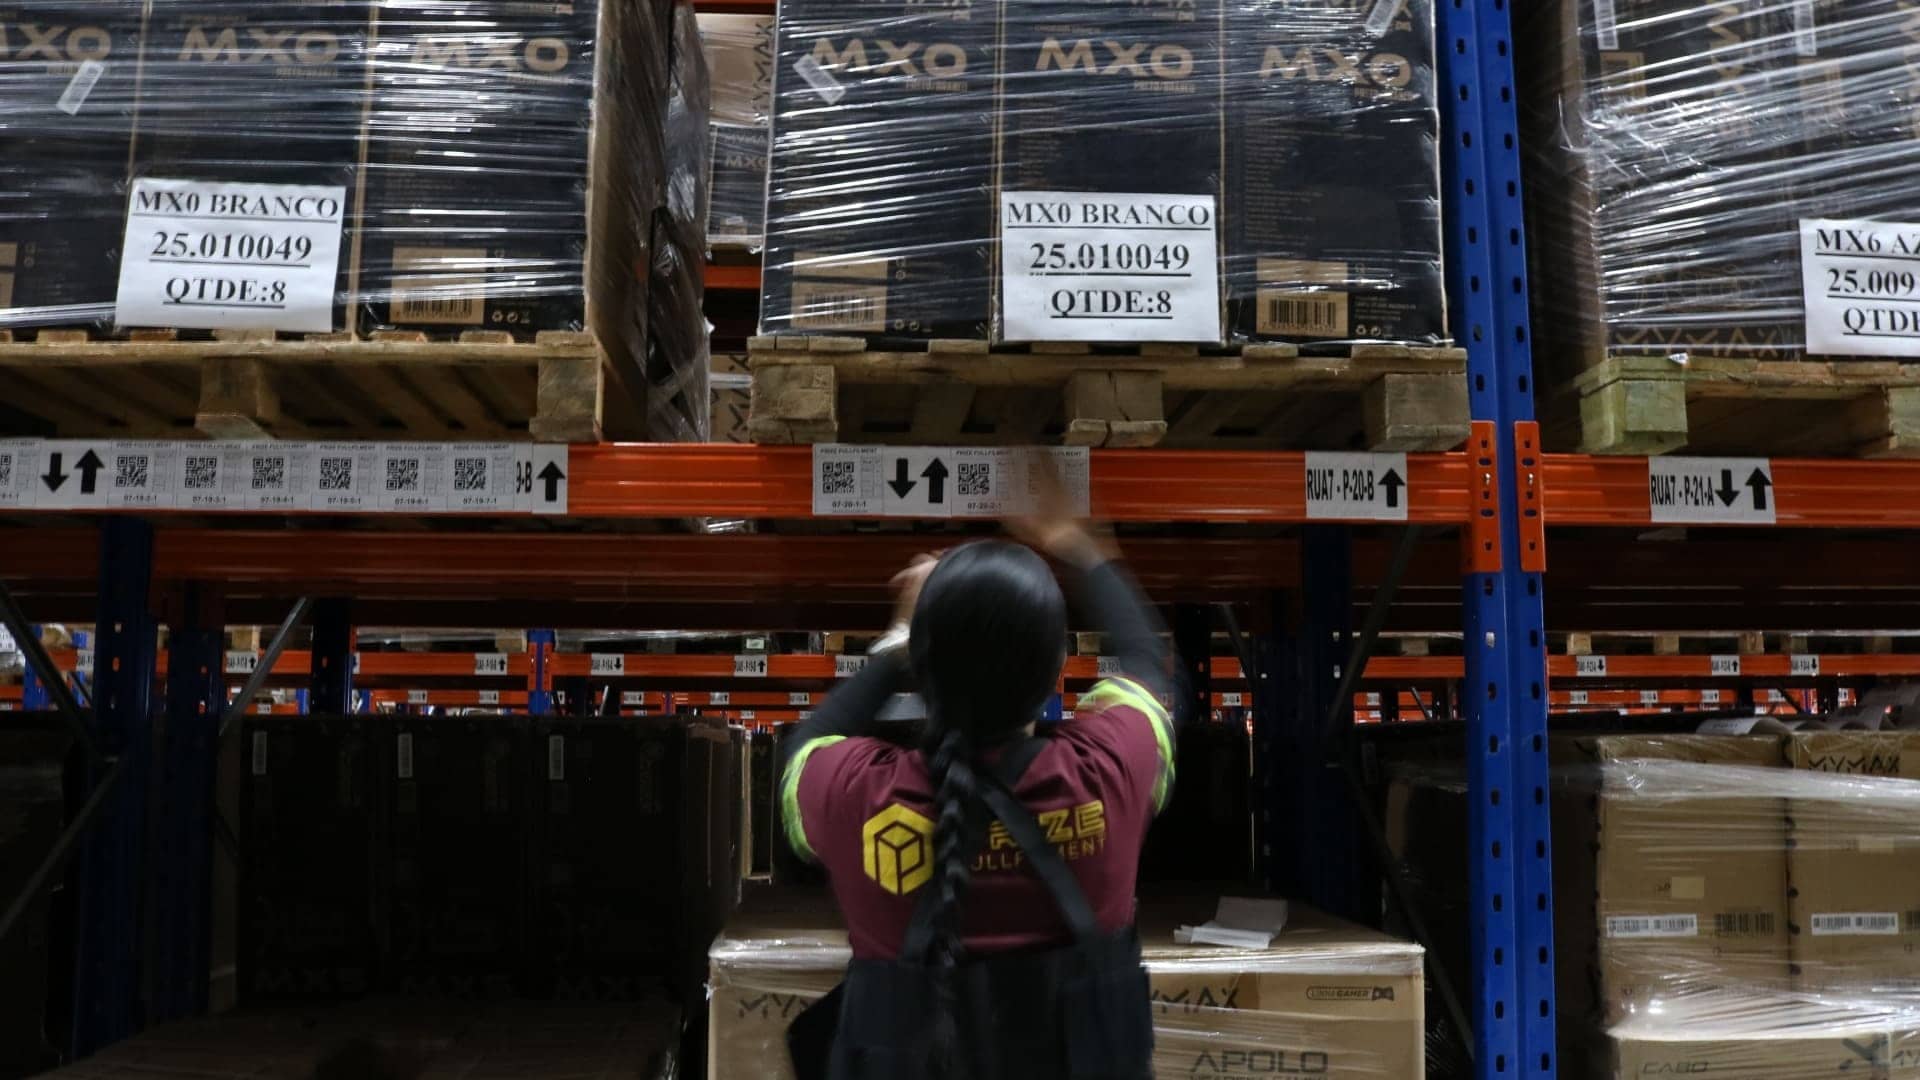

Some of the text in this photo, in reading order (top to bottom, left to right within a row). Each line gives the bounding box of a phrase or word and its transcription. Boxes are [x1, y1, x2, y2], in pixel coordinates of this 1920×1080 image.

[210, 194, 338, 217] BRANCO
[1082, 203, 1210, 226] BRANCO
[151, 231, 312, 261] 25.010049
[1816, 228, 1881, 253] MX6
[1030, 243, 1190, 270] 25.010049
[166, 278, 286, 304] QTDE:8
[1051, 289, 1172, 317] QTDE:8
[1307, 469, 1334, 500] RUA7
[1343, 469, 1375, 501] P-20-B
[1651, 475, 1676, 505] RUA7
[1684, 475, 1715, 507] P-21-A
[1808, 754, 1900, 774] MYMAX
[1337, 989, 1369, 998] GAMER
[1191, 1050, 1328, 1073] APOLO
